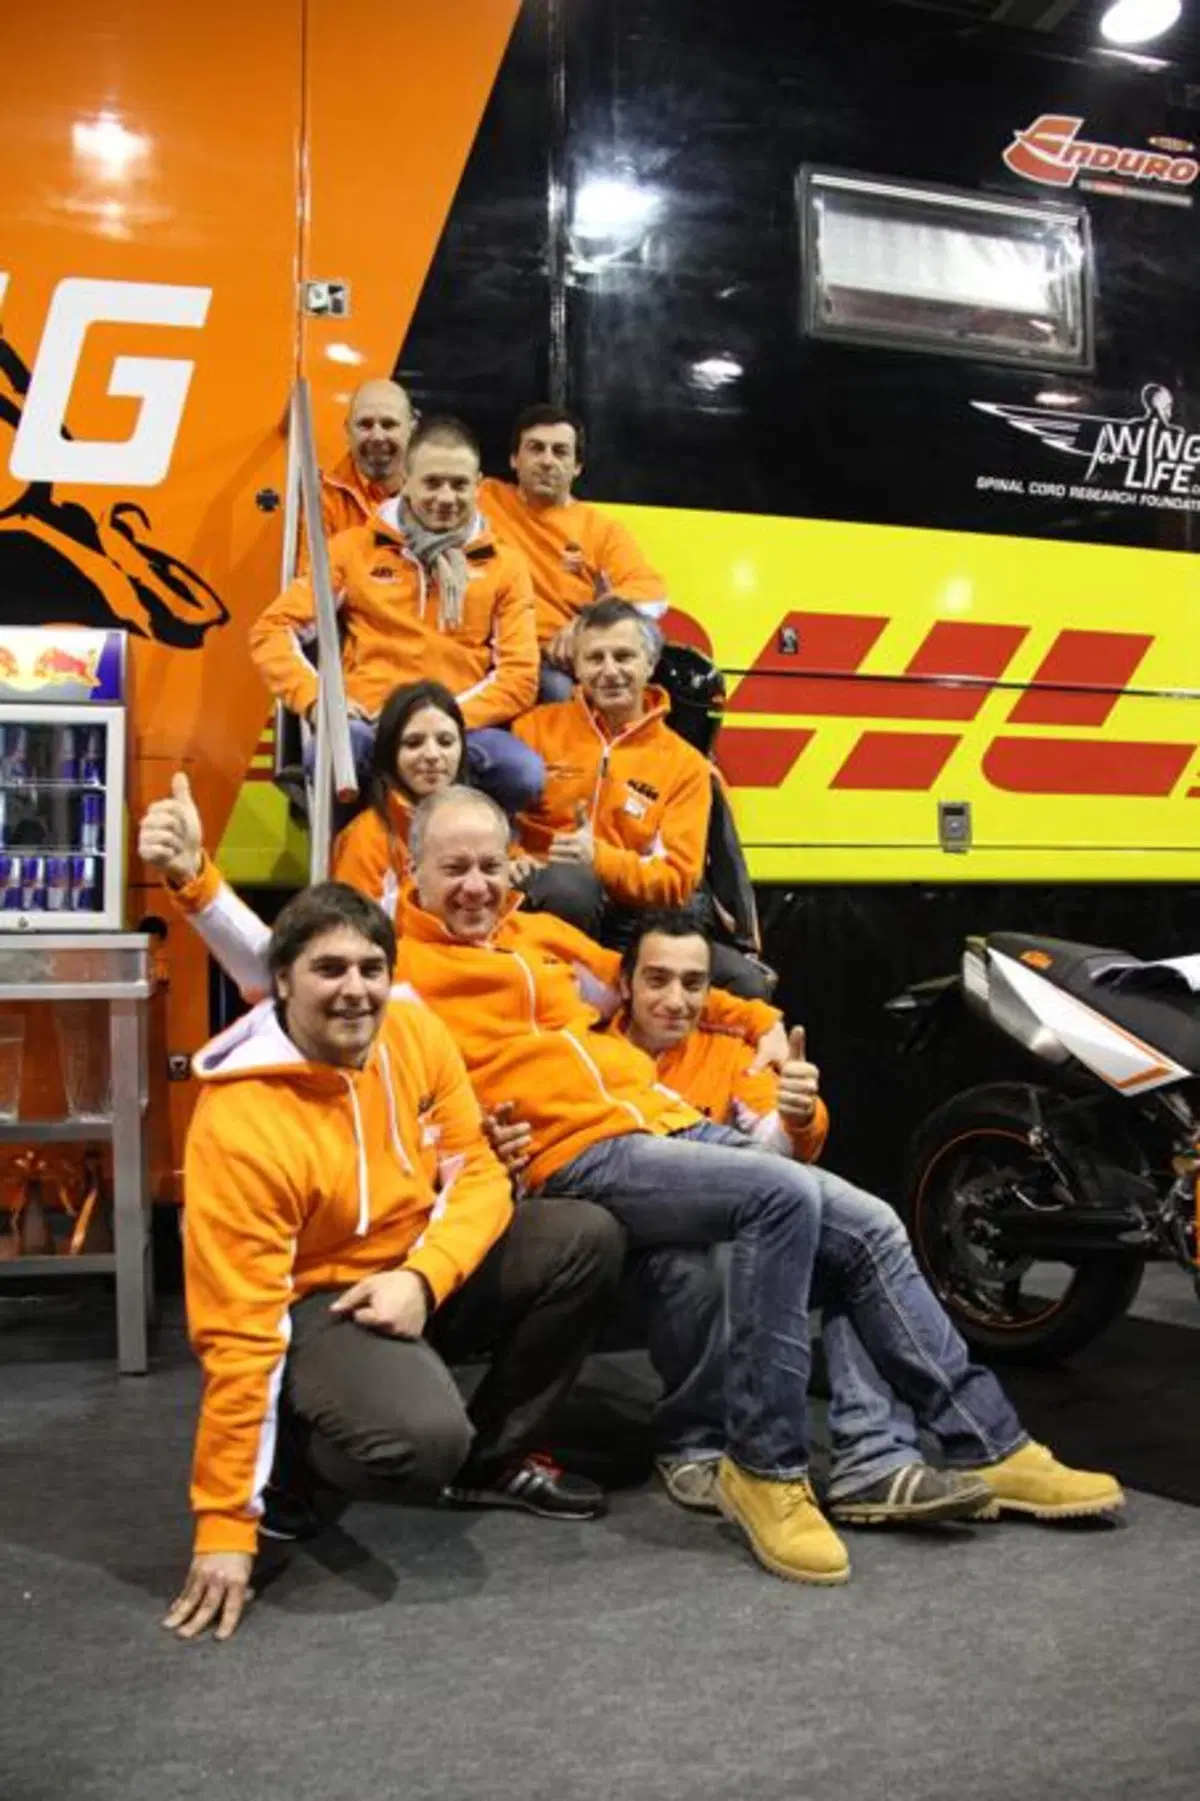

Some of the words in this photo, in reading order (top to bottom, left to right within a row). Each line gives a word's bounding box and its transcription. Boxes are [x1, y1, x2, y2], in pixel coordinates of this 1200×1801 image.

[1003, 114, 1199, 187] ENDURO
[0, 271, 212, 487] G
[976, 476, 1025, 494] SPINAL
[1028, 481, 1066, 498] CORD
[1069, 486, 1137, 505] RESEARCH
[657, 605, 1197, 797] HL
